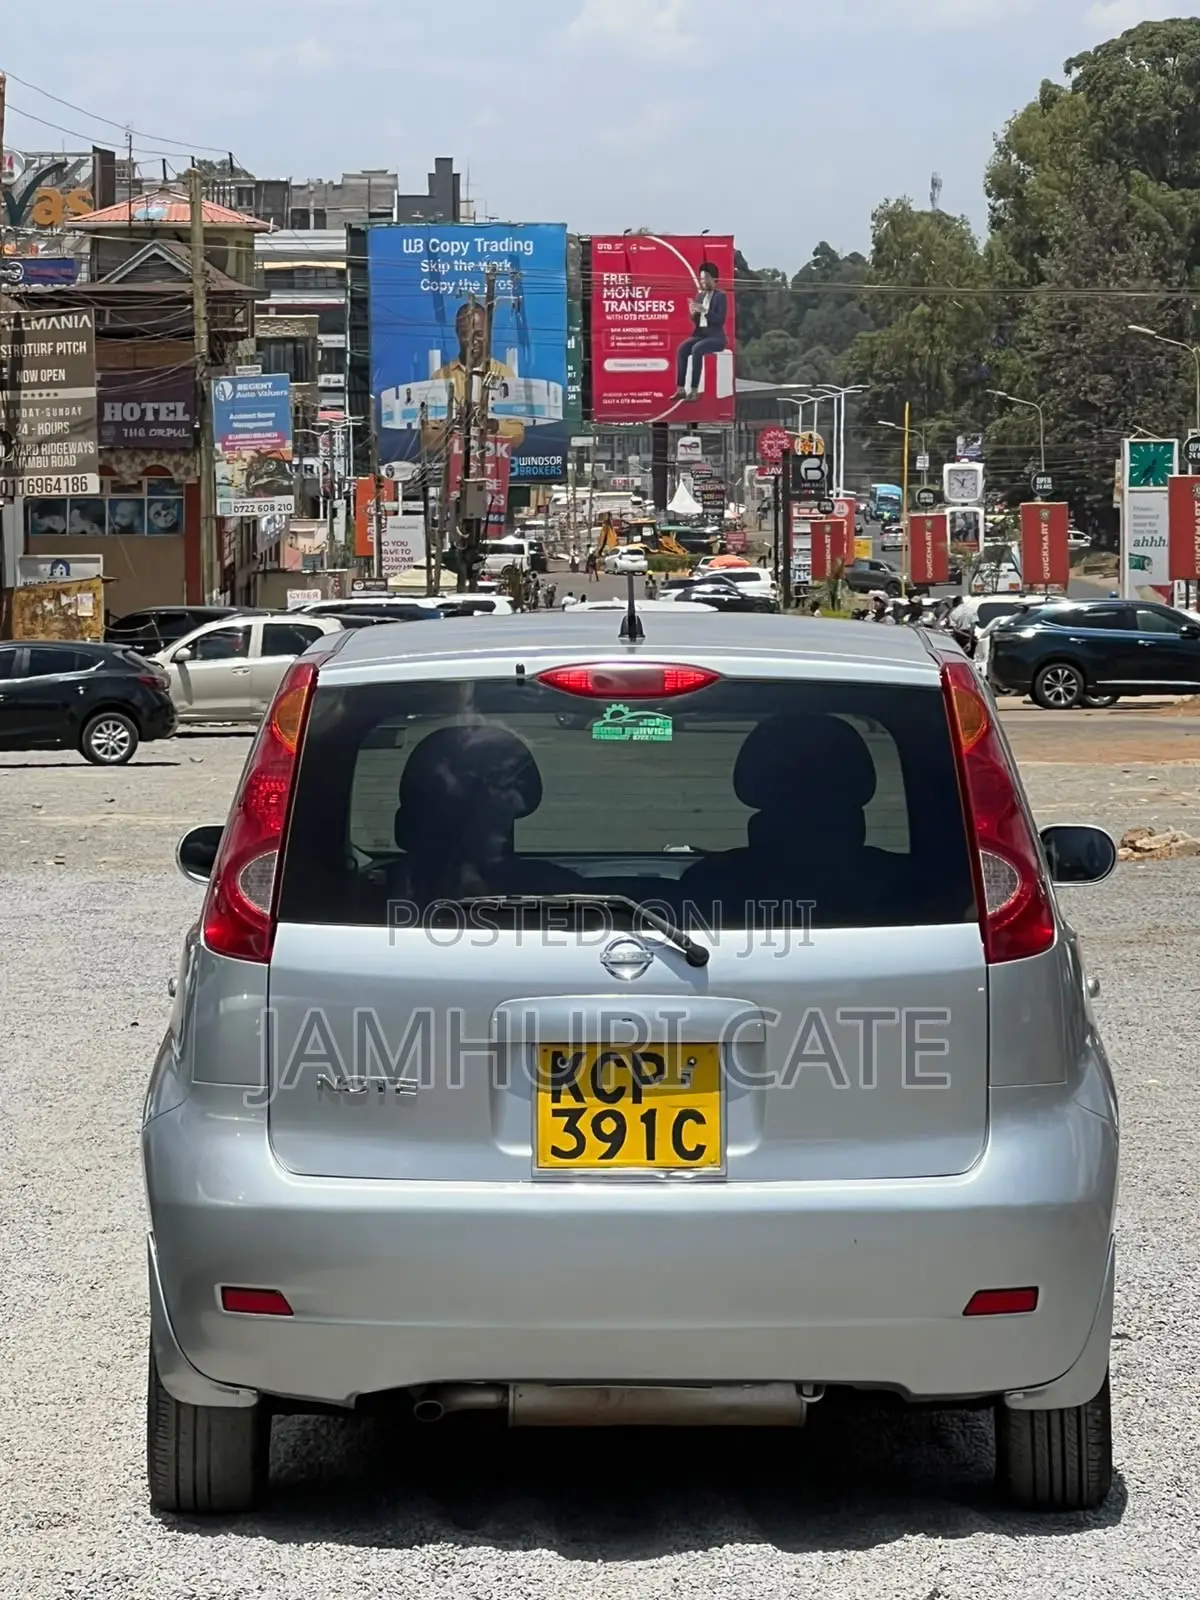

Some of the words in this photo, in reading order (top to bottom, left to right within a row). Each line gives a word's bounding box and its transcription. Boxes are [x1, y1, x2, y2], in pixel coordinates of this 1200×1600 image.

[428, 237, 471, 256] Copy
[473, 237, 534, 256] Trading
[420, 259, 451, 275] Skip
[453, 259, 477, 272] the
[420, 278, 456, 294] Copy
[458, 278, 481, 291] the
[603, 273, 632, 285] FREE
[603, 286, 651, 299] MONEY
[602, 300, 675, 313] TRANSFERS
[56, 341, 87, 355] PITCH
[16, 370, 38, 383] NOW
[40, 368, 66, 382] OPEN
[236, 382, 273, 391] REGENT
[236, 391, 256, 399] Auto
[257, 389, 288, 397] Valuers
[103, 402, 190, 421] HOTEL
[16, 423, 28, 436] 24
[38, 422, 70, 436] HOURS
[41, 442, 95, 456] RIDGEWAYS
[51, 454, 76, 468] ROAD
[518, 455, 563, 467] WINDSOR
[518, 465, 562, 476] BROKERS
[1, 475, 88, 495] 0116964186
[233, 504, 255, 513] 0722
[257, 503, 275, 512] 608
[277, 502, 292, 511] 210
[925, 531, 933, 579] QUICKMART
[1041, 523, 1050, 580] QUICKMART
[551, 1050, 666, 1105] KCP
[316, 1073, 418, 1098] NOTE
[551, 1107, 707, 1162] 391C
